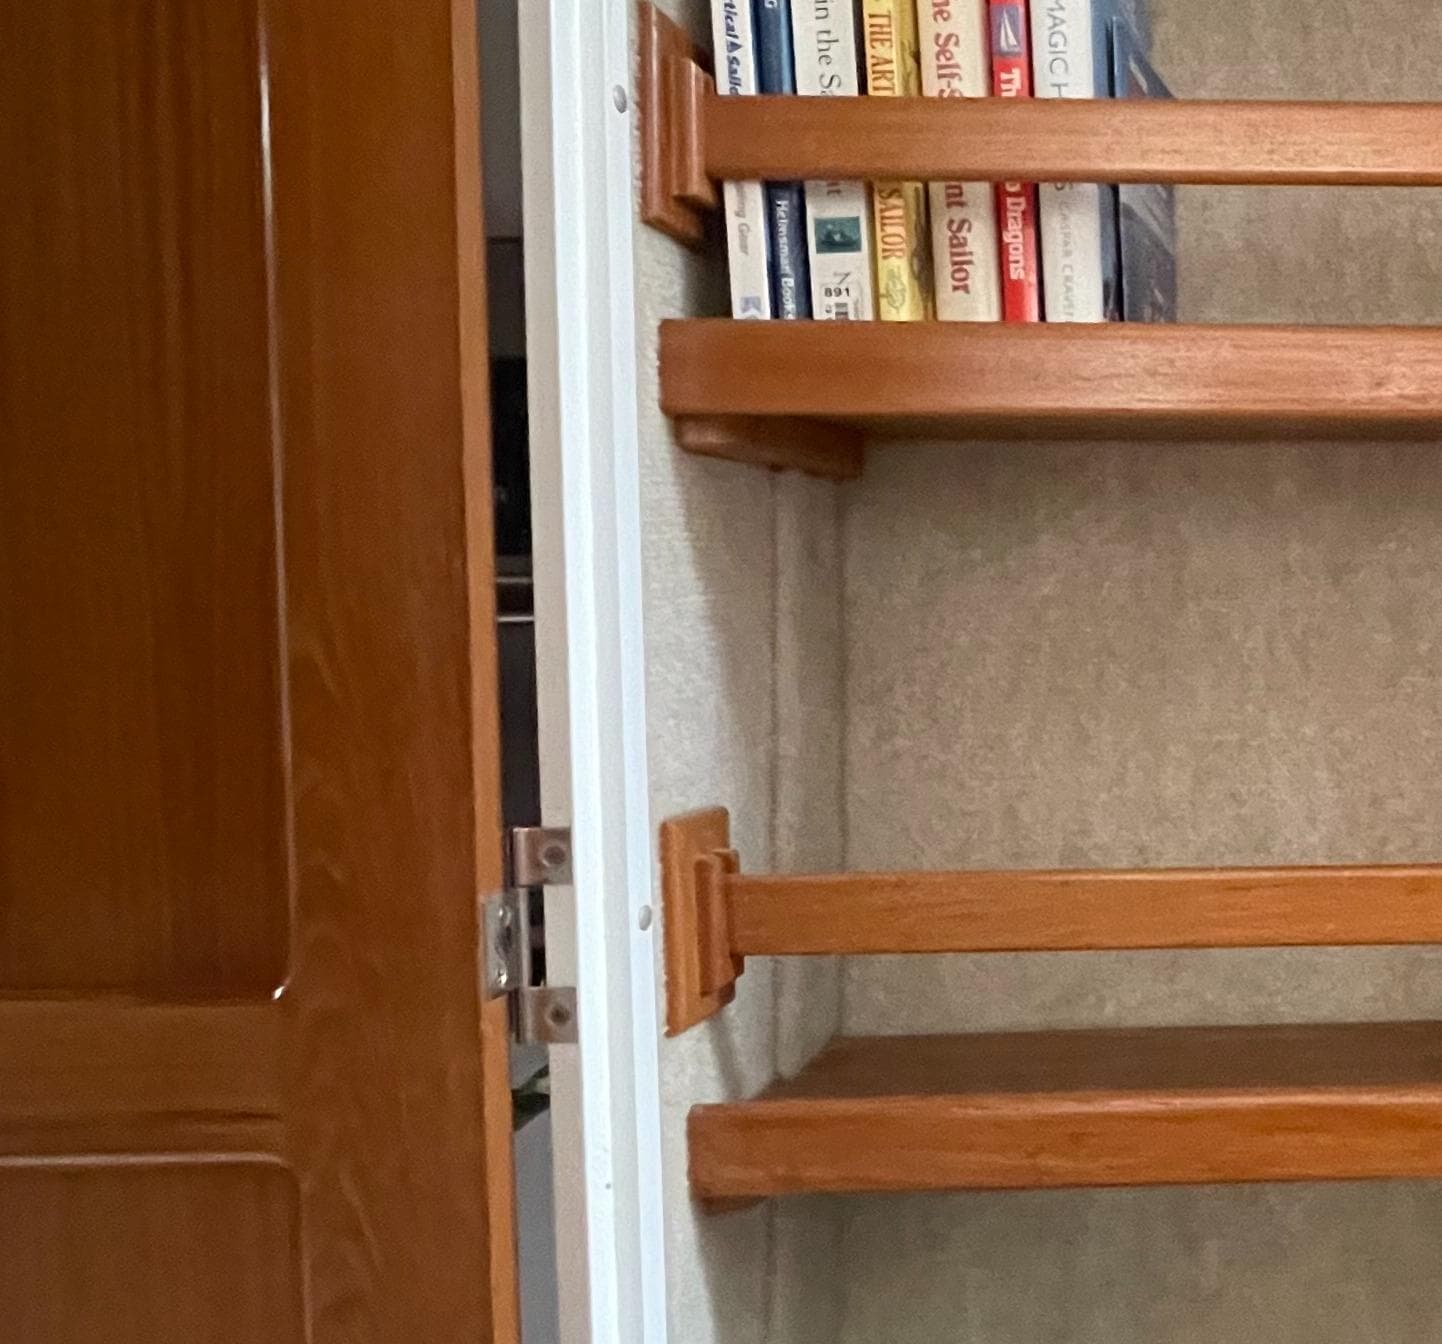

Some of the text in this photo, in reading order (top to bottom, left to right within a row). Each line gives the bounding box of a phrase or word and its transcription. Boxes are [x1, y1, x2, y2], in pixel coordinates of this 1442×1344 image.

[814, 0, 834, 21] in
[868, 9, 894, 49] THE
[816, 29, 840, 66] the
[727, 55, 743, 96] Sailo
[879, 187, 906, 260] SAILOR
[1002, 196, 1028, 281] Dragons
[946, 218, 976, 295] Sailor
